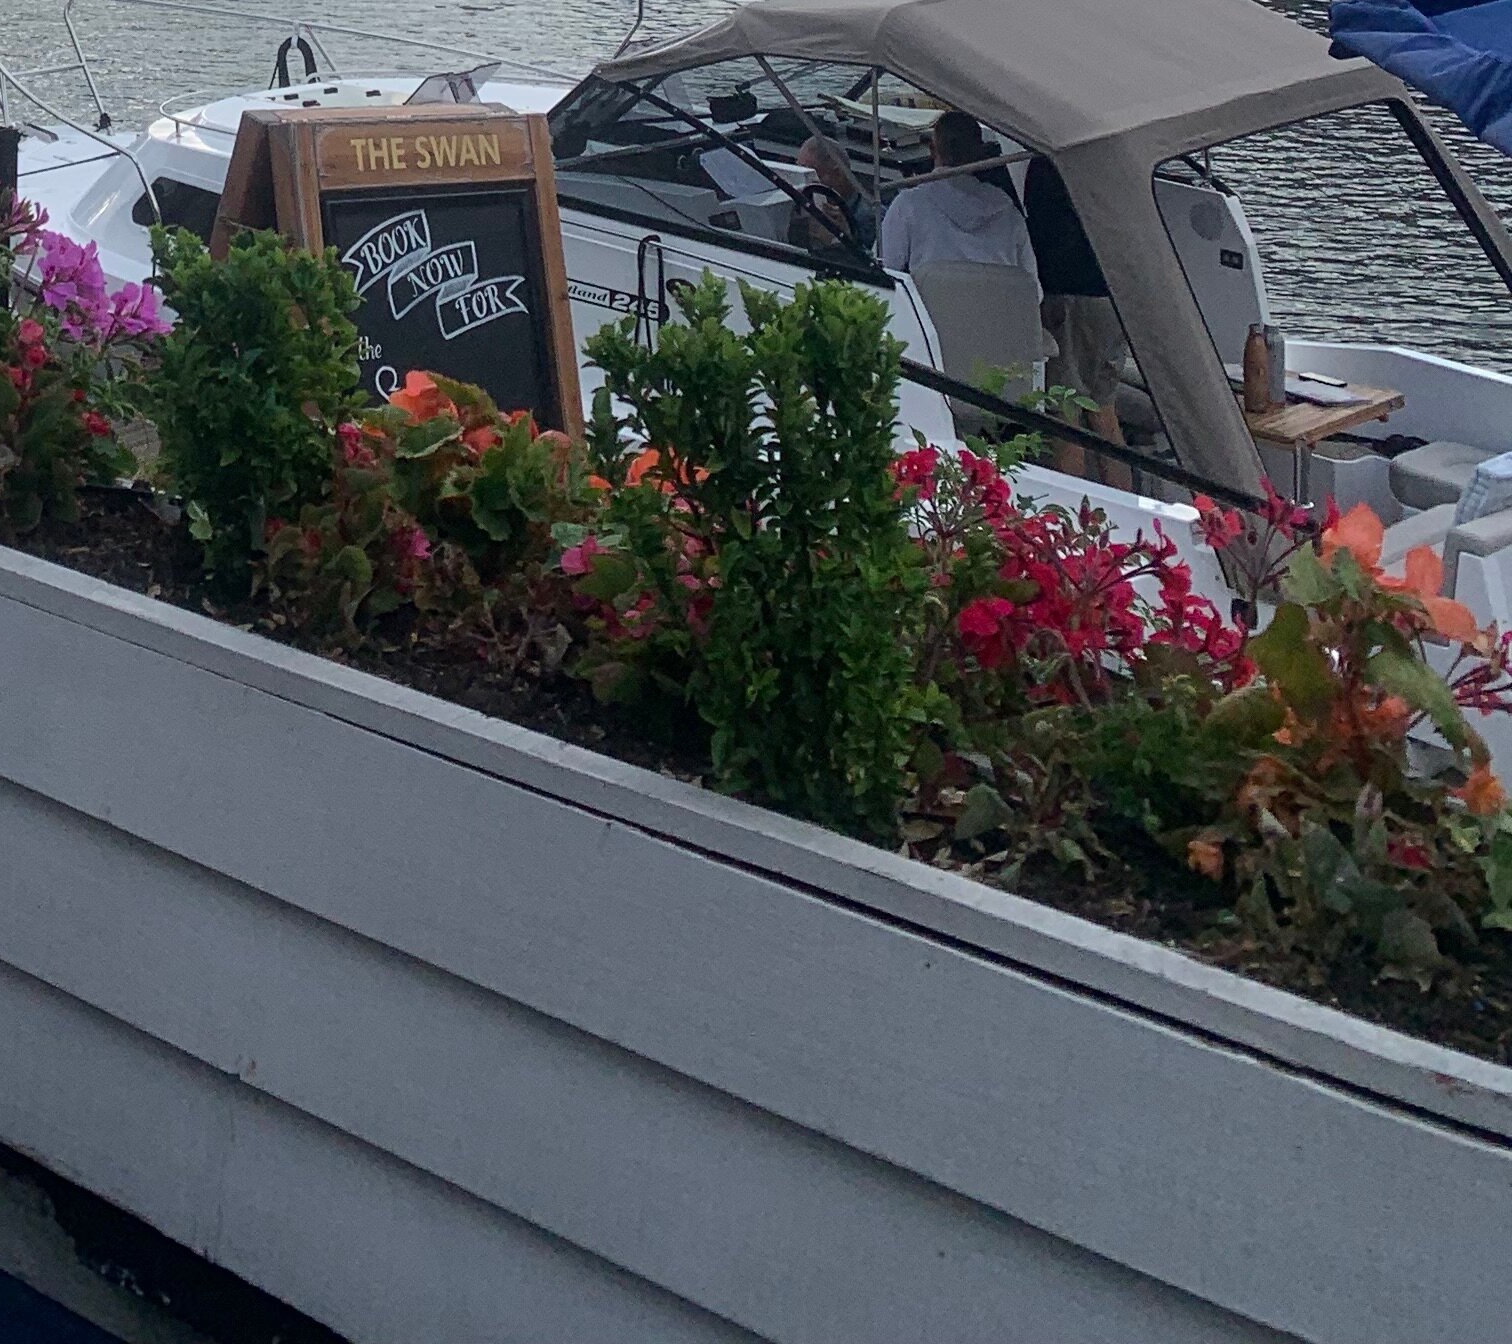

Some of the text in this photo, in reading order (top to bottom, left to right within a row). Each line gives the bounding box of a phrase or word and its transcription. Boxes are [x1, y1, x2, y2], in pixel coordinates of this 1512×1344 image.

[350, 133, 502, 172] THE SWAN
[360, 217, 428, 275] BOOK
[407, 250, 465, 299] NOW
[455, 284, 509, 325] FOR
[358, 335, 383, 361] the
